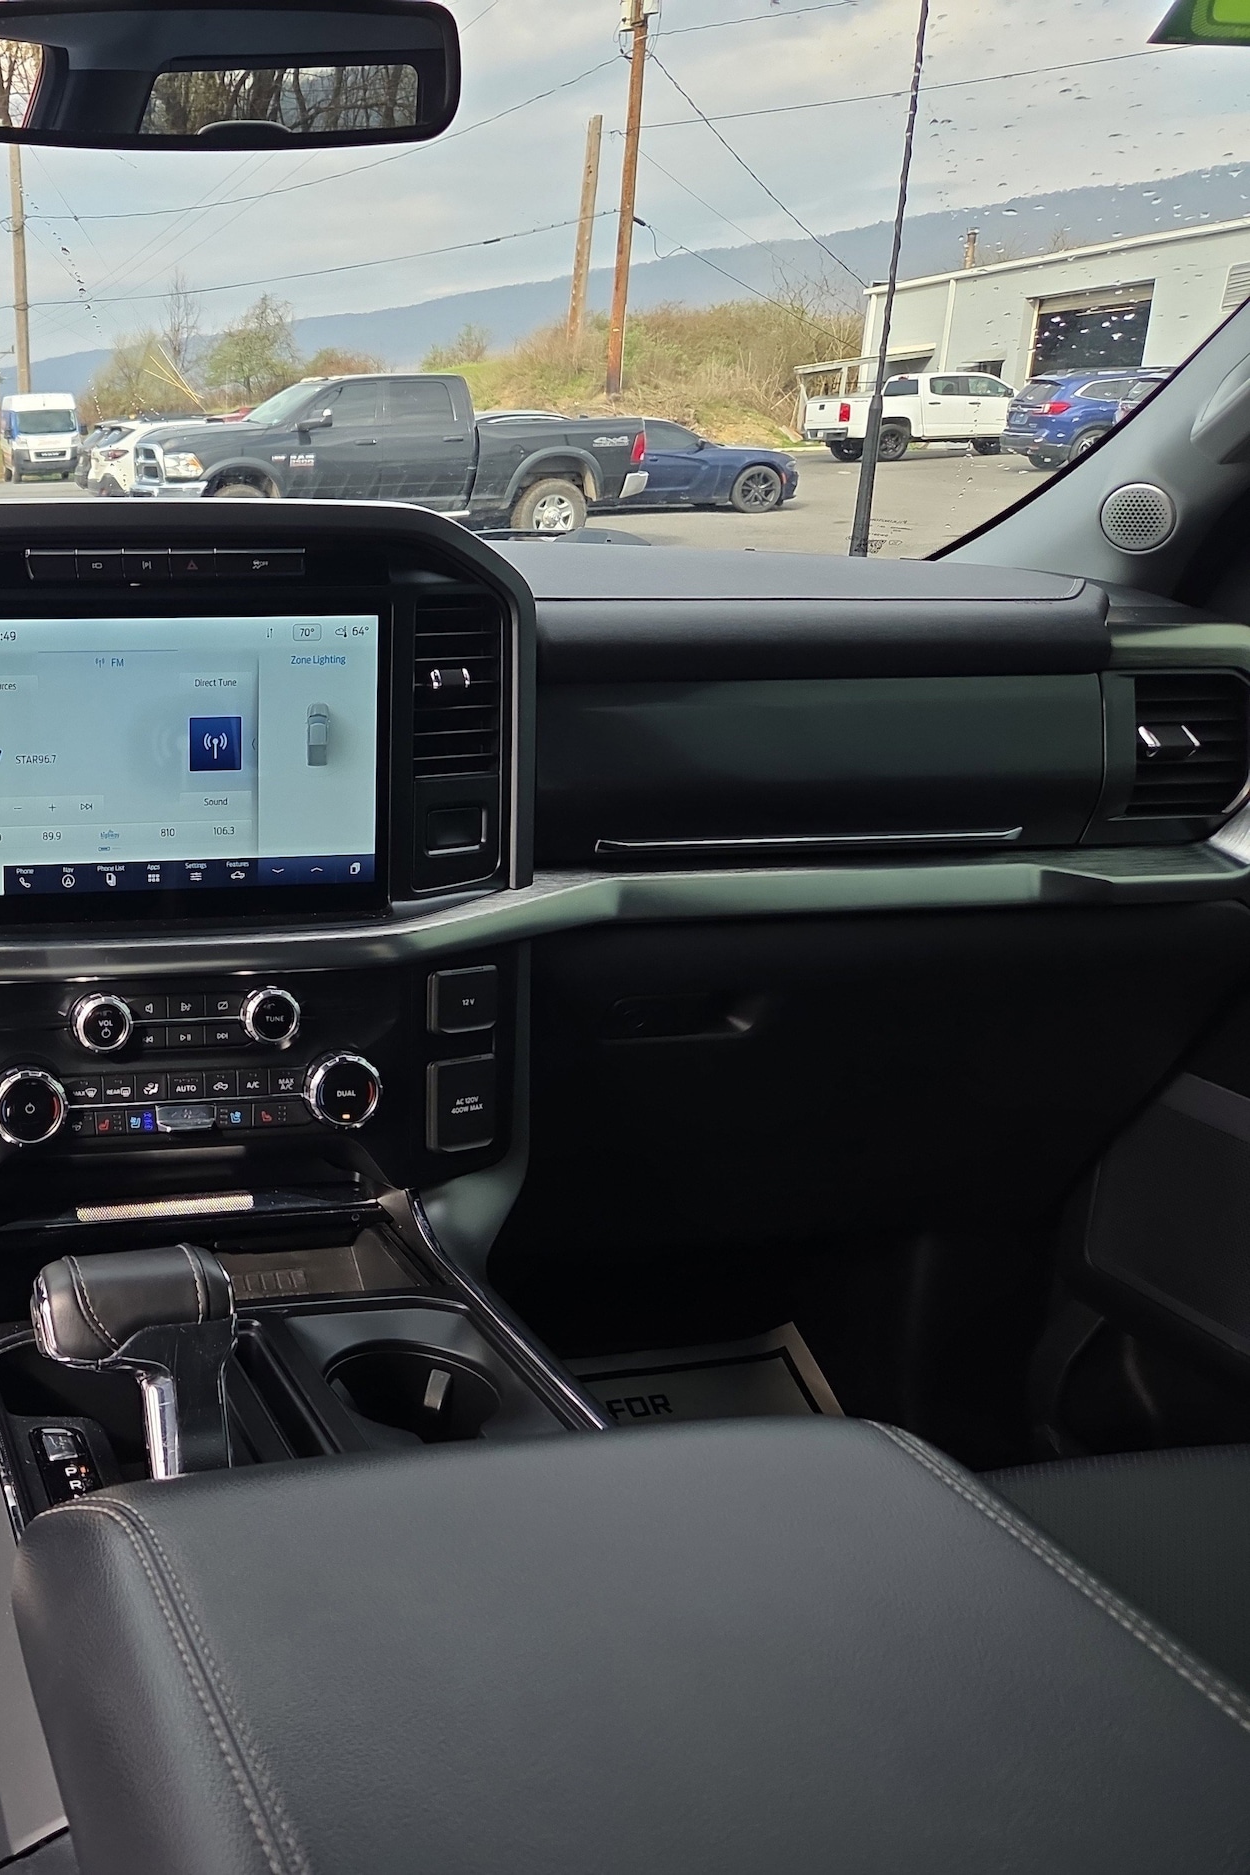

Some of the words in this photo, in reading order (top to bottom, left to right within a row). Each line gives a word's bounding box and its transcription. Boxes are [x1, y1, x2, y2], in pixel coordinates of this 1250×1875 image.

[299, 628, 315, 637] 70°
[351, 626, 370, 637] 64°
[111, 658, 124, 667] FM
[290, 655, 312, 665] Zone
[313, 655, 346, 666] Lighting
[194, 678, 216, 687] Direct
[218, 678, 237, 687] Tune
[15, 754, 57, 765] STAR96.7
[204, 797, 228, 807] Sound
[160, 828, 175, 838] 810
[213, 826, 235, 836] 106.3
[42, 831, 62, 841] 89.9
[97, 865, 114, 873] Phone
[185, 862, 207, 870] Settings
[226, 861, 249, 869] Features
[16, 867, 34, 875] Phone
[63, 866, 75, 874] Nav
[176, 1084, 197, 1093] AUTO
[246, 1081, 261, 1089] A/C
[605, 1394, 673, 1420] FOR
[64, 1467, 77, 1477] P
[69, 1480, 82, 1490] R
